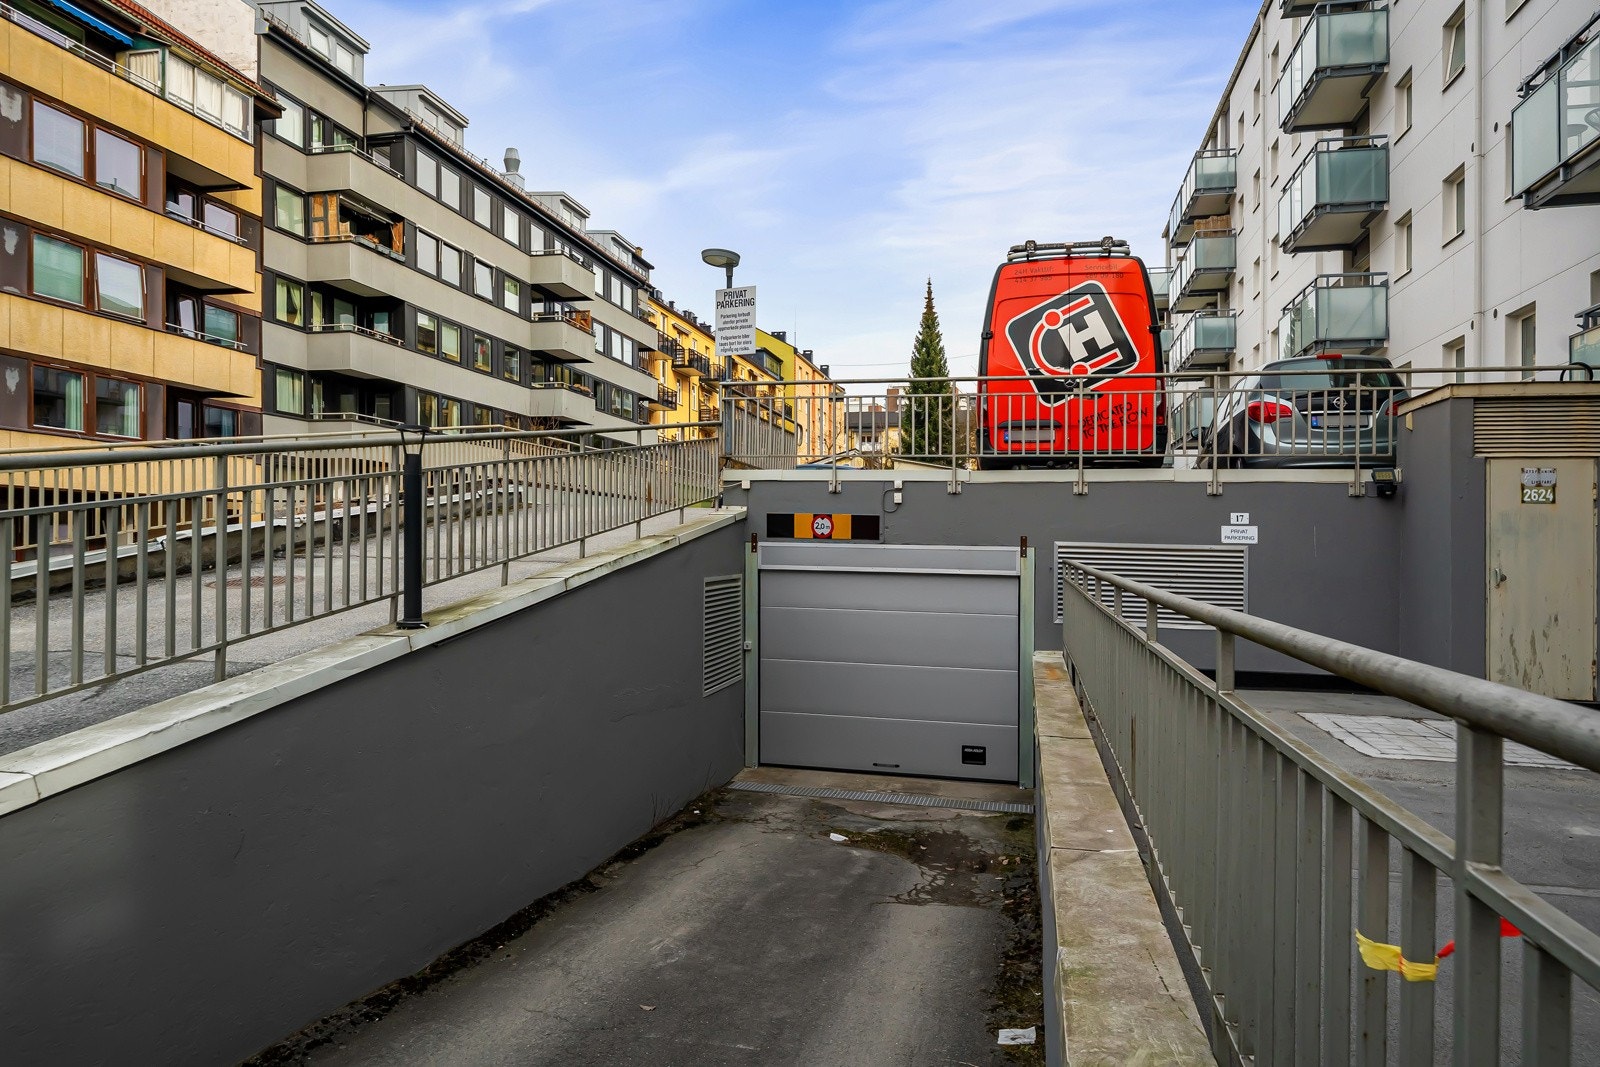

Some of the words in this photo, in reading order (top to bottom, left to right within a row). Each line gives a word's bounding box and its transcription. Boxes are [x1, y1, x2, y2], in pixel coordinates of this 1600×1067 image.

[723, 290, 748, 301] PRIVAT
[716, 298, 755, 309] PARKERING
[1058, 310, 1115, 362] H
[1078, 402, 1132, 428] DEDICATED
[1082, 427, 1097, 439] TO
[1523, 488, 1554, 502] 2624
[1236, 514, 1244, 522] 17
